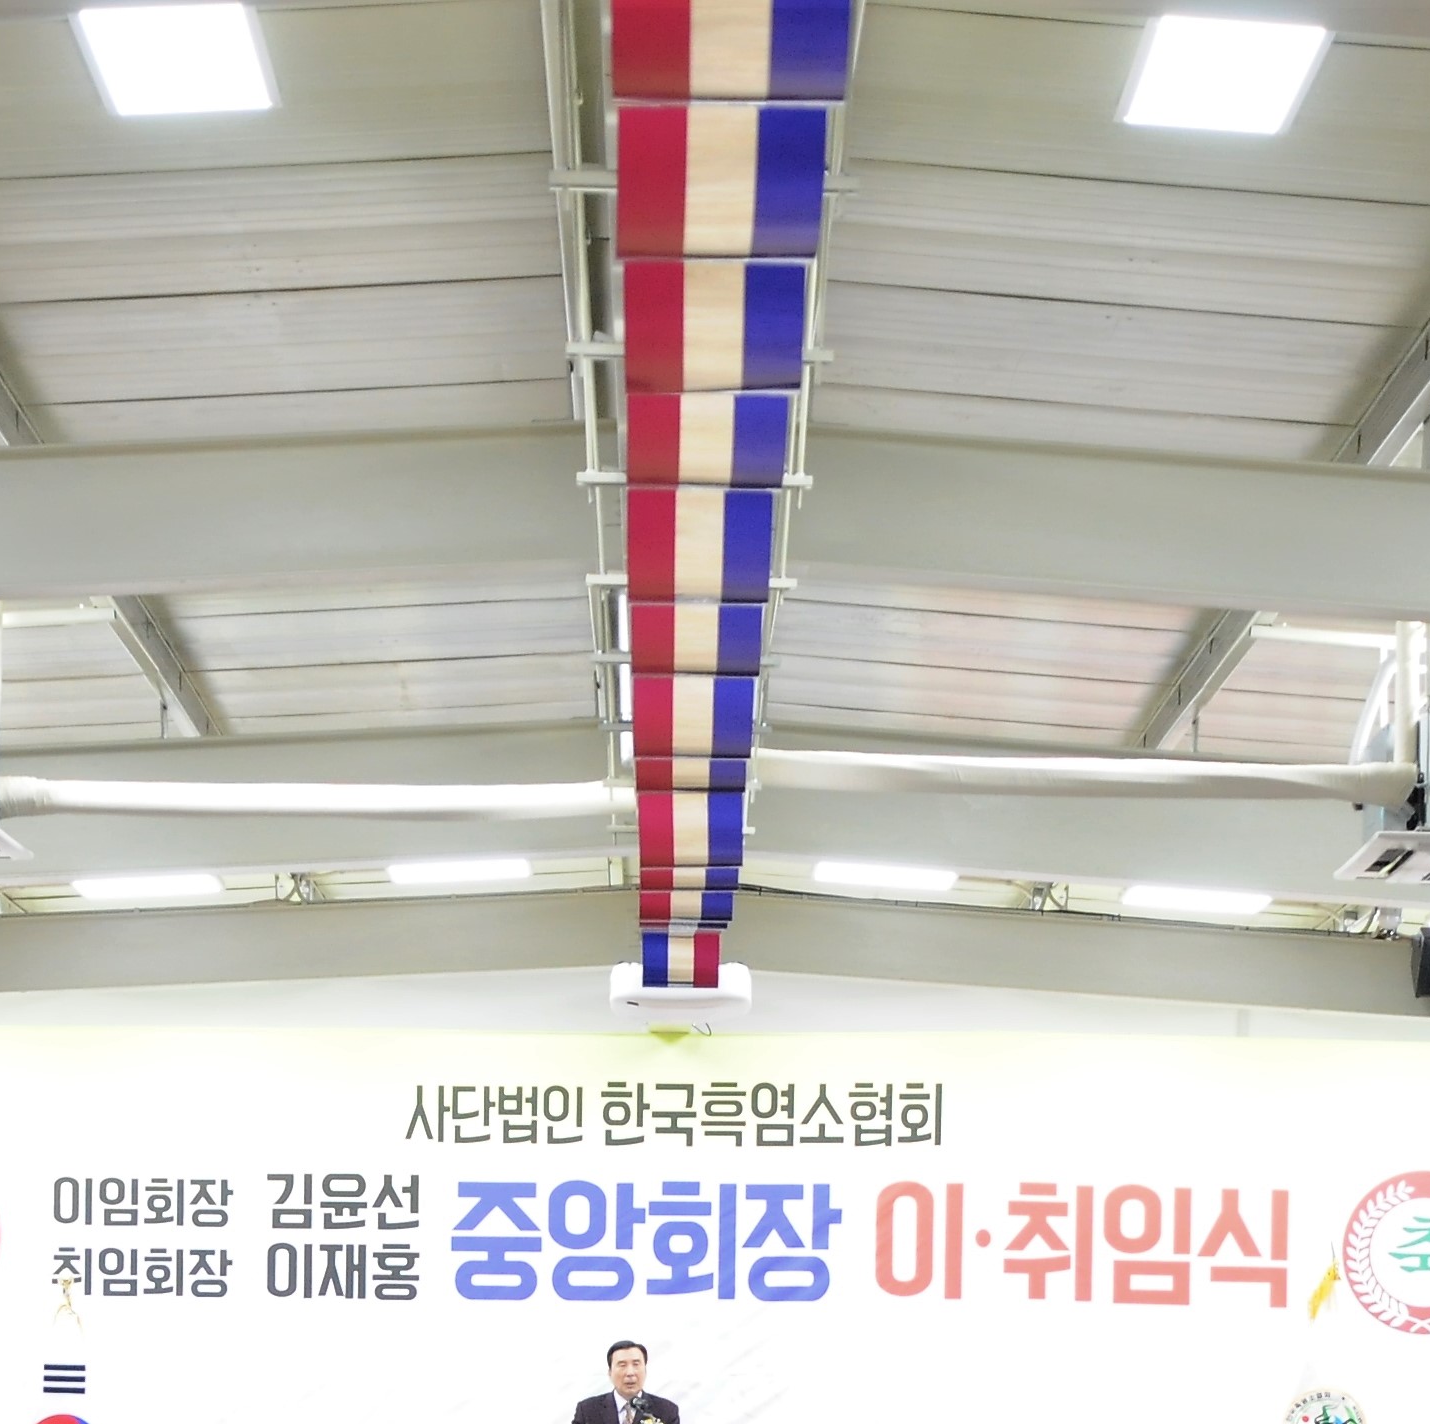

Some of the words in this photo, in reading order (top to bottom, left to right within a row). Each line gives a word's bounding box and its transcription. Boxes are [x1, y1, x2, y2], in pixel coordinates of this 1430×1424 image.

[405, 1085, 584, 1144] 사단법인
[601, 1081, 945, 1148] 한국흑염소협회
[53, 1177, 236, 1230] 이임회장
[267, 1173, 421, 1232] 김윤선
[51, 1245, 235, 1300] 취임회장
[267, 1242, 421, 1303] 이재홍
[450, 1180, 844, 1304] 중앙회장
[875, 1181, 1290, 1309] 이·취임식
